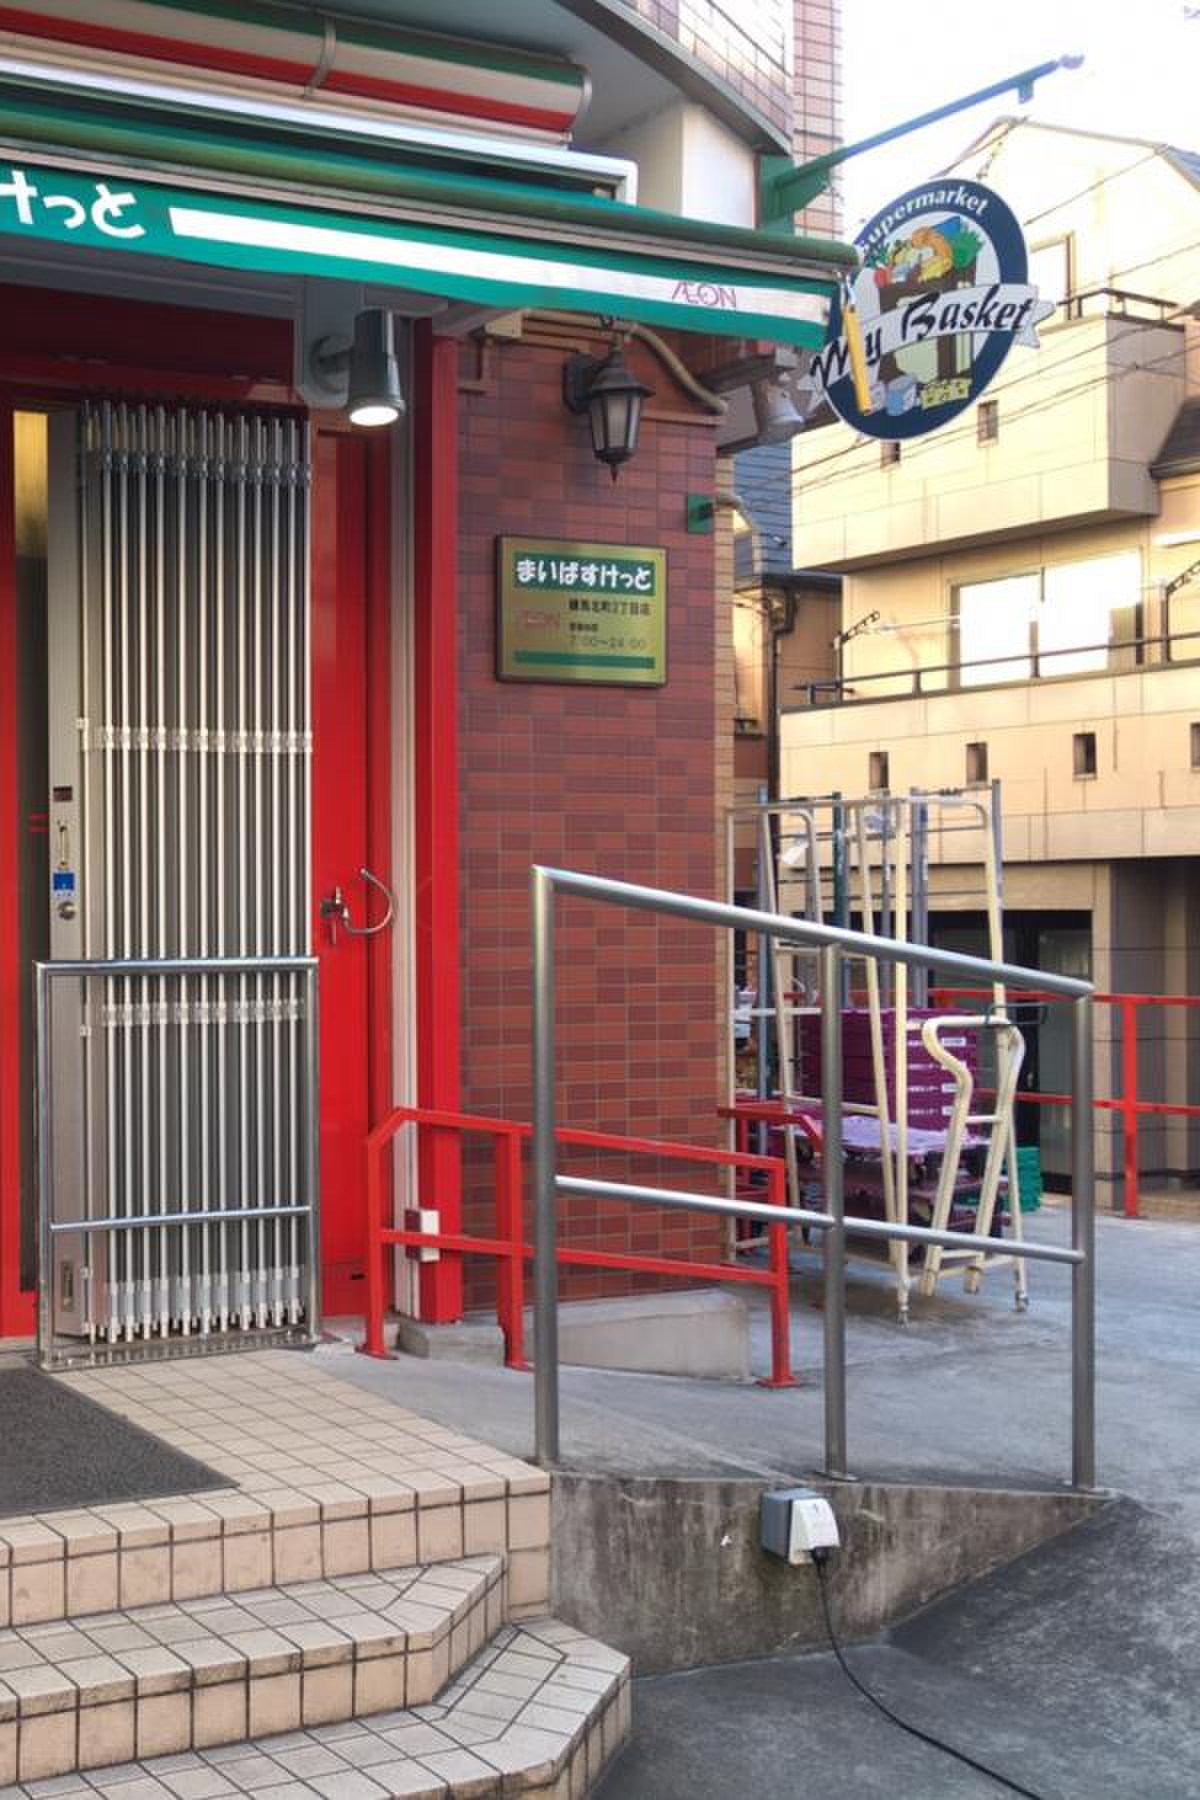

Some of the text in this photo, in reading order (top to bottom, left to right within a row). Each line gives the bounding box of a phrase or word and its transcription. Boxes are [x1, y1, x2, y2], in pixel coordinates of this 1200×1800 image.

[902, 283, 1034, 341] Basket
[516, 560, 652, 591] まいばすけっと
